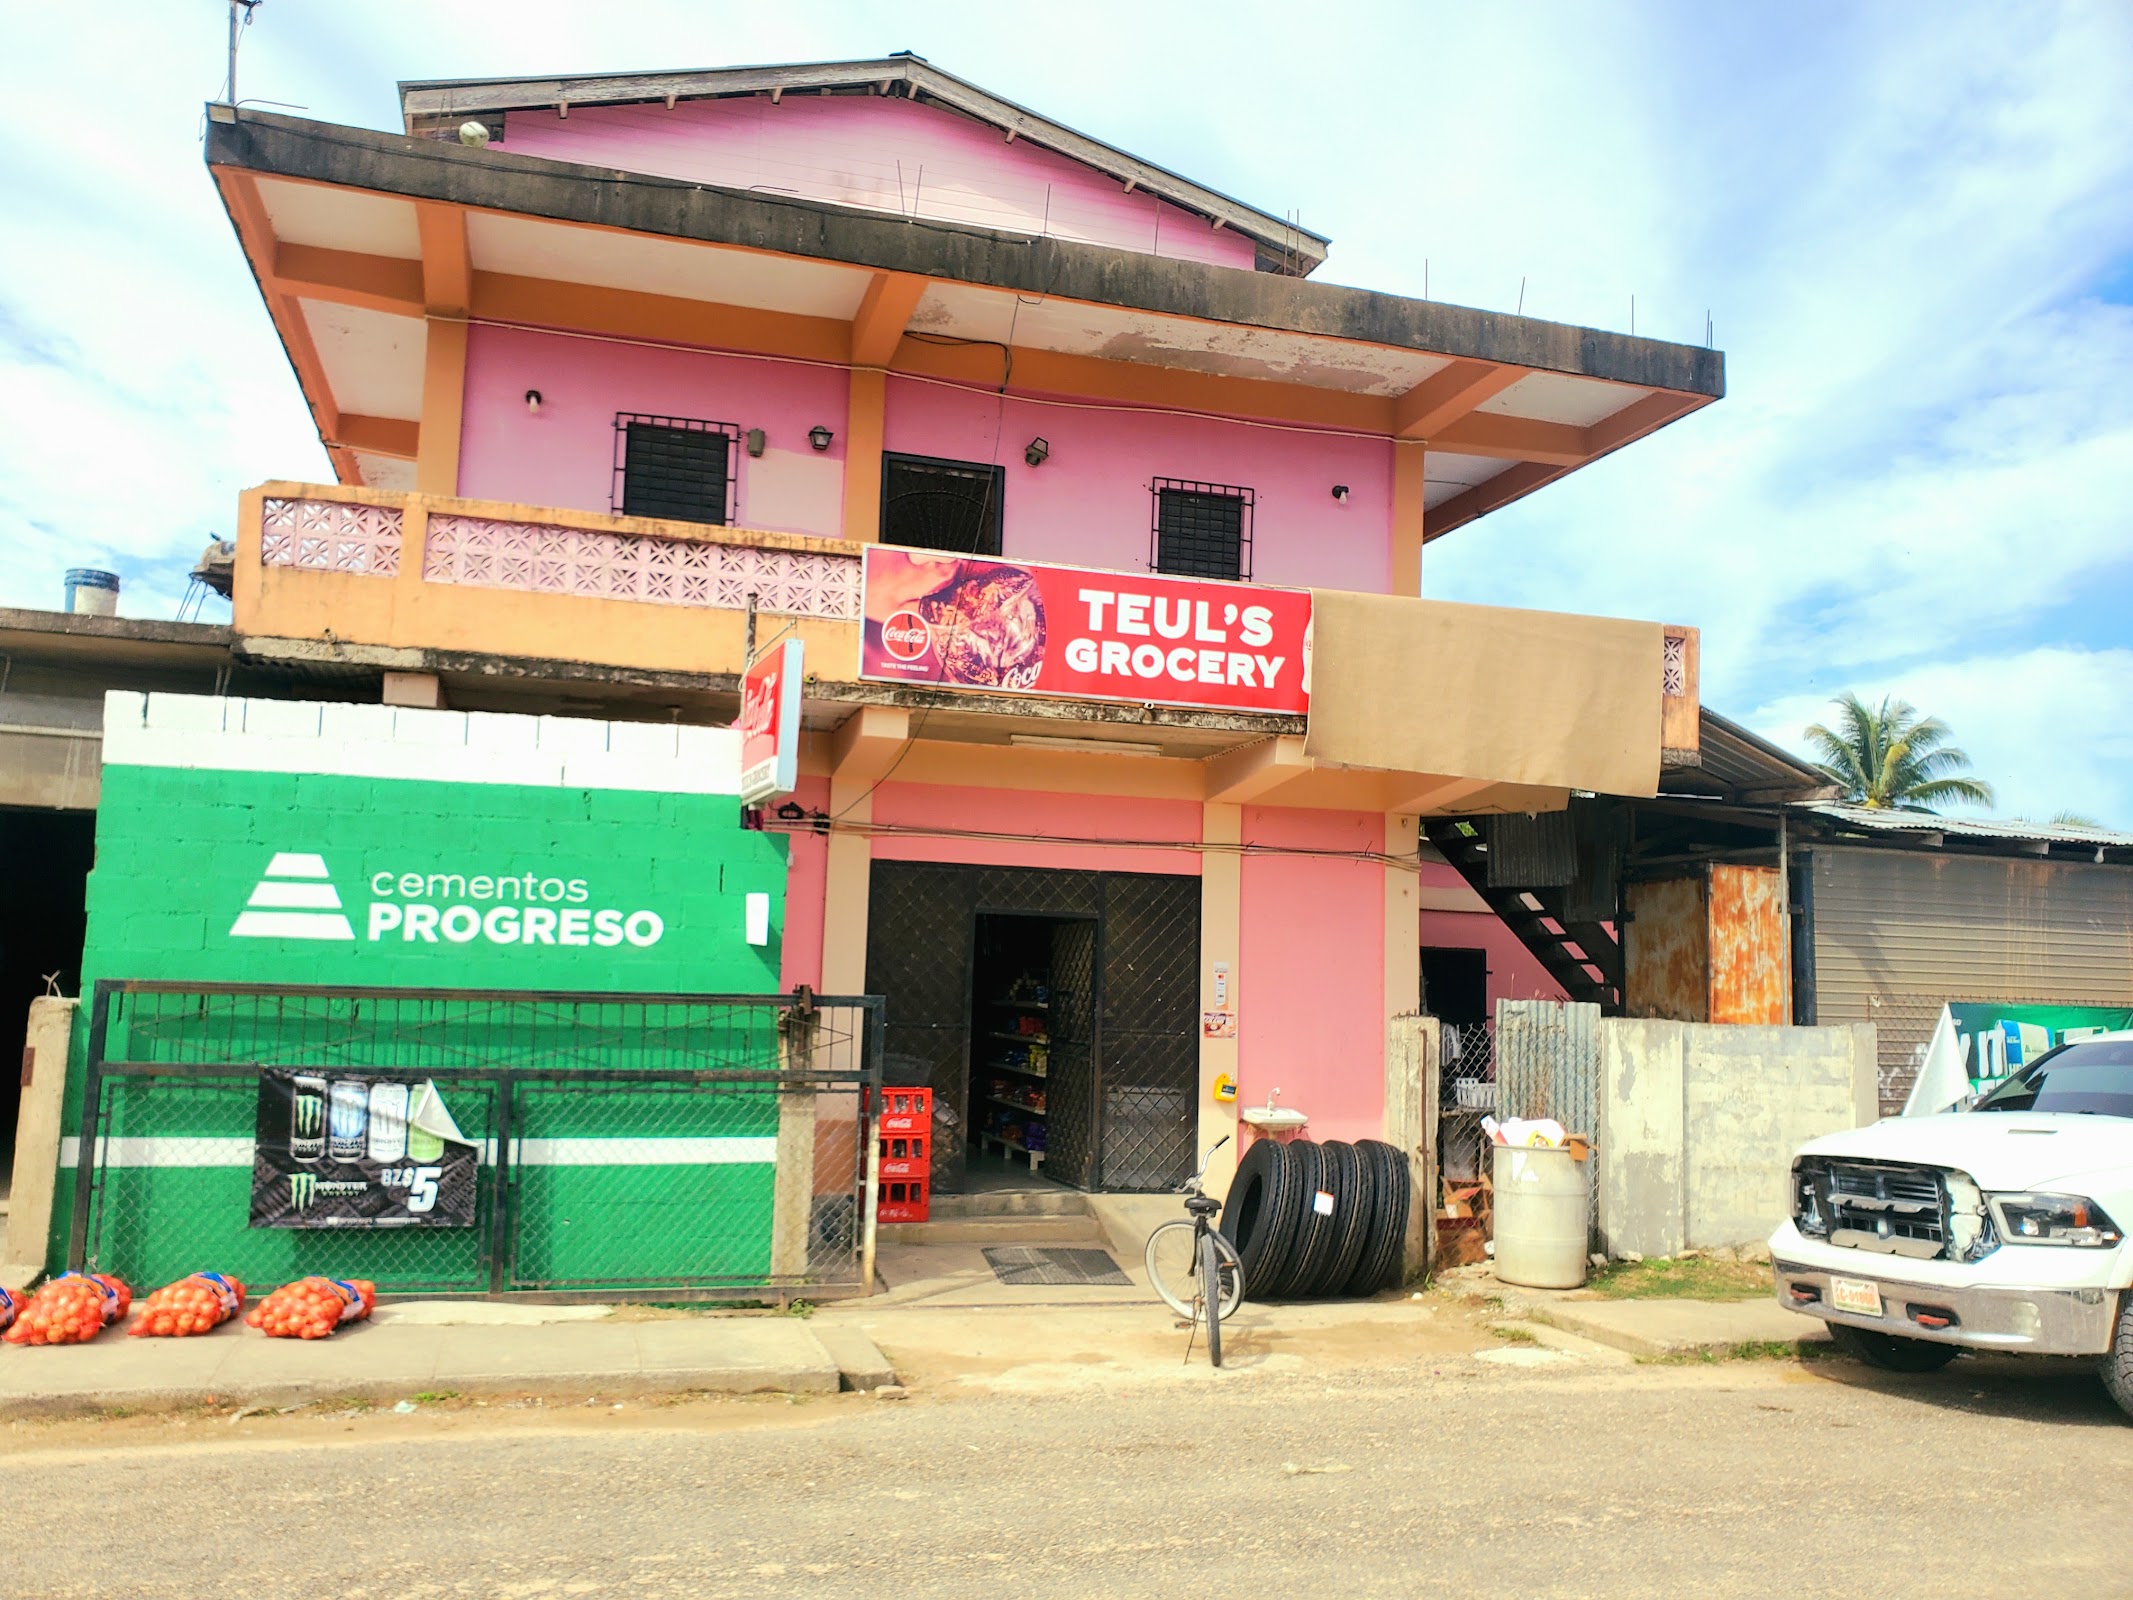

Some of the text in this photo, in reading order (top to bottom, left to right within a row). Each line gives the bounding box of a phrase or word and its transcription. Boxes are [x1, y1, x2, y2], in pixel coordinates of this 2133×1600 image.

[885, 626, 927, 644] Coca-Cola
[880, 662, 928, 673] TASTE THE FEELING
[1065, 637, 1286, 690] GROCERY
[371, 871, 589, 902] cementos
[368, 902, 664, 948] PROGRESO
